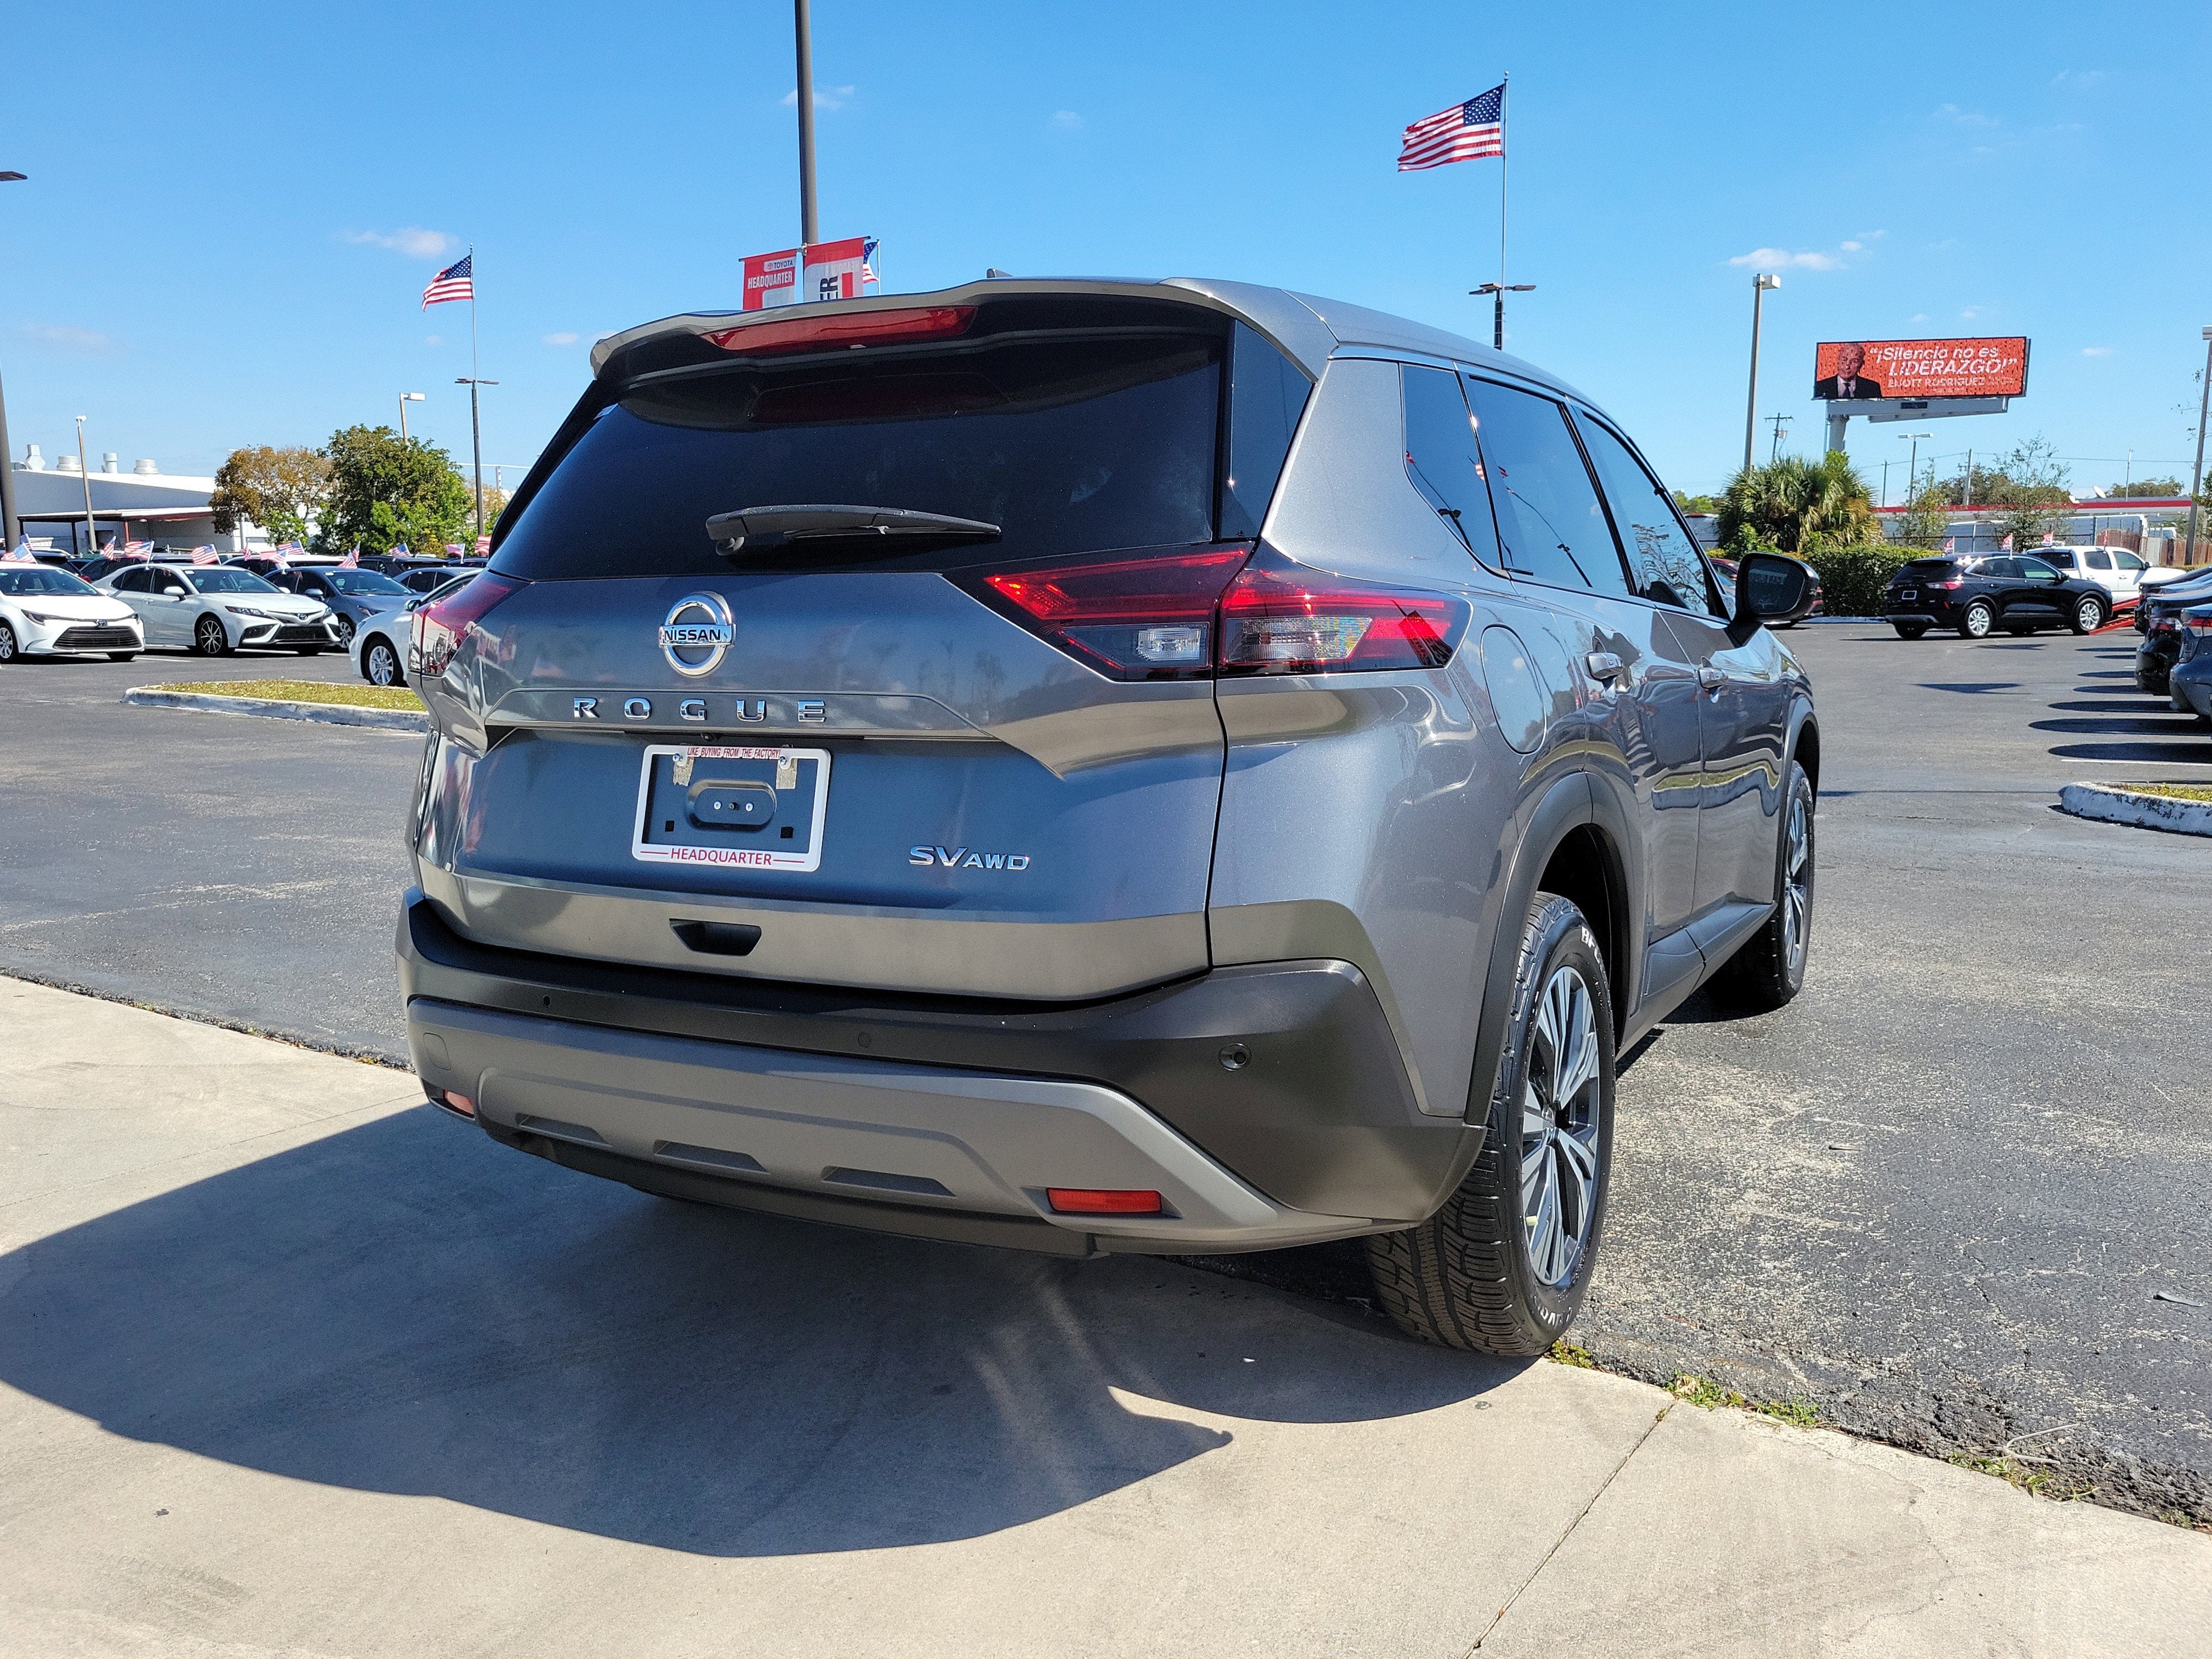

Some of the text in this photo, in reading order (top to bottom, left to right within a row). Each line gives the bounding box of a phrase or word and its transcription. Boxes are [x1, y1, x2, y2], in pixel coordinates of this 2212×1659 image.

[774, 259, 793, 269] TOYOTA
[748, 271, 793, 290] HEADQUARTER
[1953, 348, 1974, 358] no
[1978, 347, 1999, 358] es
[1925, 376, 1985, 387] RODRIGUEZ
[664, 629, 721, 641] NISSAN
[573, 697, 826, 722] ROGUE
[687, 747, 781, 759] LIKE BUYING FROM THE FACTORY!
[670, 848, 772, 866] HEADQUARTER
